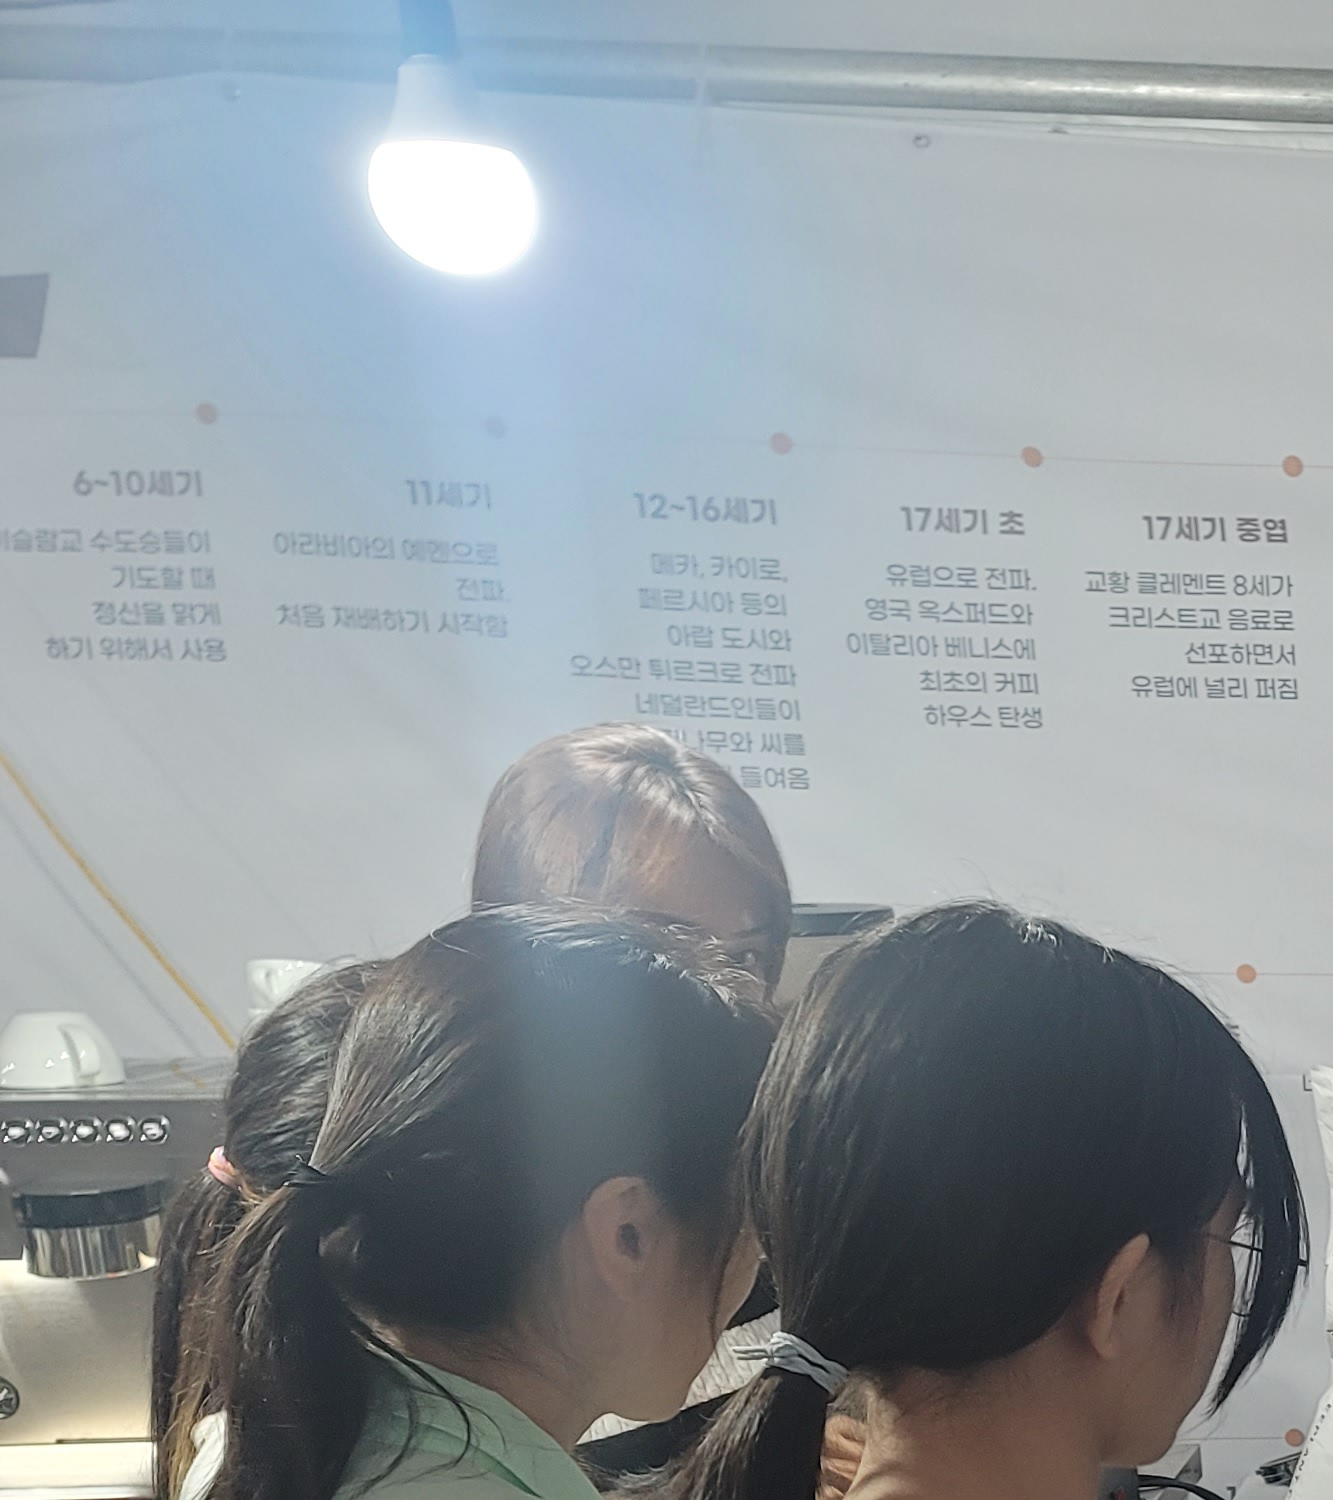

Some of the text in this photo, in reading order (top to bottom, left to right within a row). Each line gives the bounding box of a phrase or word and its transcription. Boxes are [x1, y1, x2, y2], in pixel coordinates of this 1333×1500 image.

[73, 469, 203, 497] 6~10세기
[404, 479, 491, 510] 11세기
[633, 492, 778, 526] 12~16세기
[900, 506, 1025, 536] 17세기 초
[90, 529, 211, 554] 수도승들이
[1142, 515, 1289, 543] 17세기 중엽
[272, 531, 395, 560] 아라비아의
[111, 566, 216, 590] 기도할 때
[456, 577, 505, 602] 전파
[886, 563, 979, 588] 유럽으로
[1084, 570, 1293, 598] 교황 클레멘트 8세가
[92, 602, 222, 627] 정신을 맑게
[638, 587, 788, 617] 페르시아 등의
[865, 597, 1033, 625] 영국 옥스퍼드와
[276, 603, 508, 638] 처음 재배하기 시작함
[1109, 606, 1295, 631] 크리스트교 음료로
[44, 636, 227, 663] 하기 위해서 사용
[667, 624, 792, 652] 아랍 도시와
[846, 632, 1036, 660] 이탈리아 베니스에
[1184, 642, 1297, 666] 선포하면서
[570, 655, 797, 687] 오스만 튀르크로 전파
[919, 669, 1039, 695] 최초의 커피
[1131, 675, 1299, 700] 유럽에 널리 퍼짐
[635, 692, 801, 721] 네덜란드인들이
[923, 704, 1043, 729] 하우스 탄생
